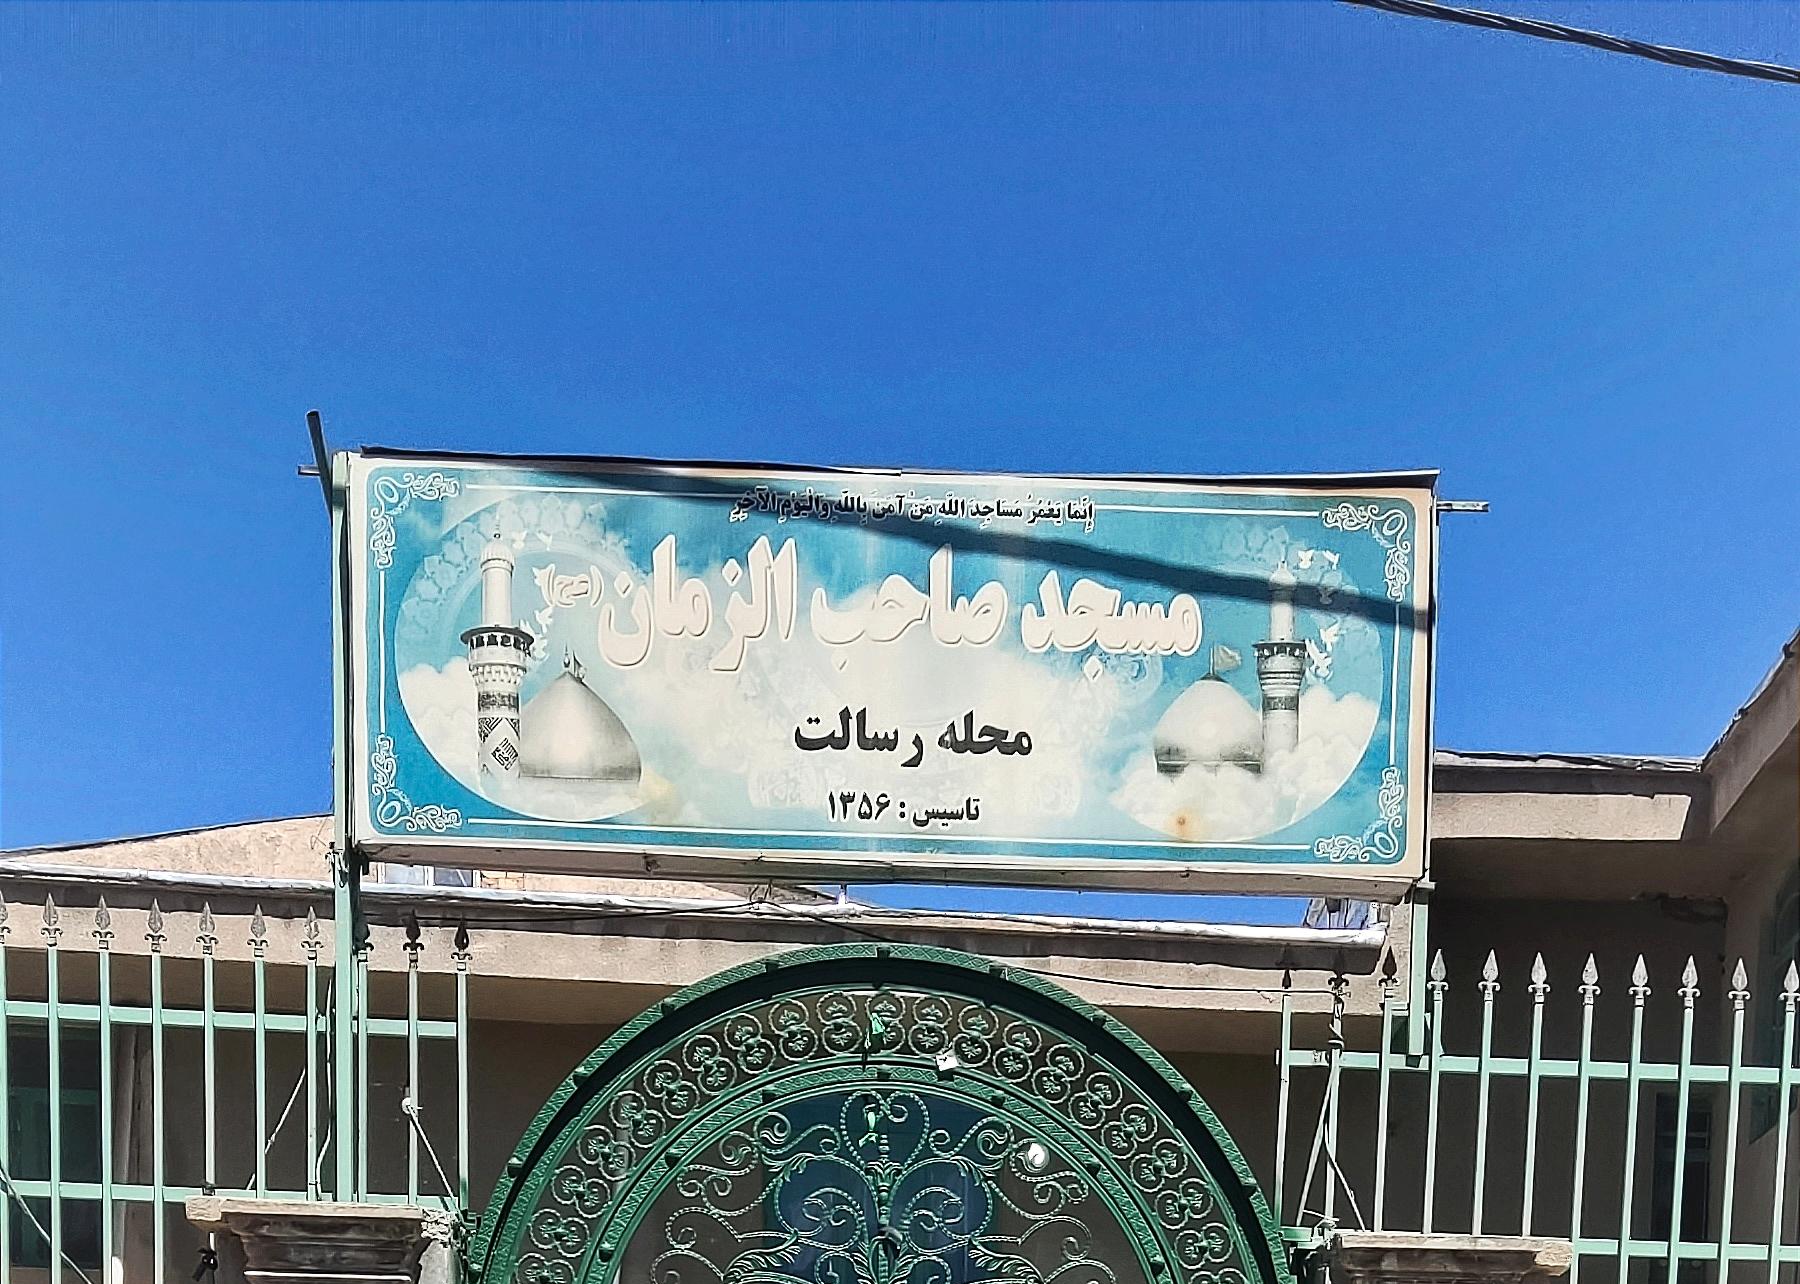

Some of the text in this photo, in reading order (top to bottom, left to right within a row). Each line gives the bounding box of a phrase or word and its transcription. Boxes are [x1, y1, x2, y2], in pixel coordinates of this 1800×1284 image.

[600, 534, 800, 673] الزمان
[810, 544, 1008, 674] صاحب
[1019, 569, 1203, 682] مسجد
[794, 706, 1033, 767] محله رسالت
[828, 790, 891, 821] ۱۳۵۶
